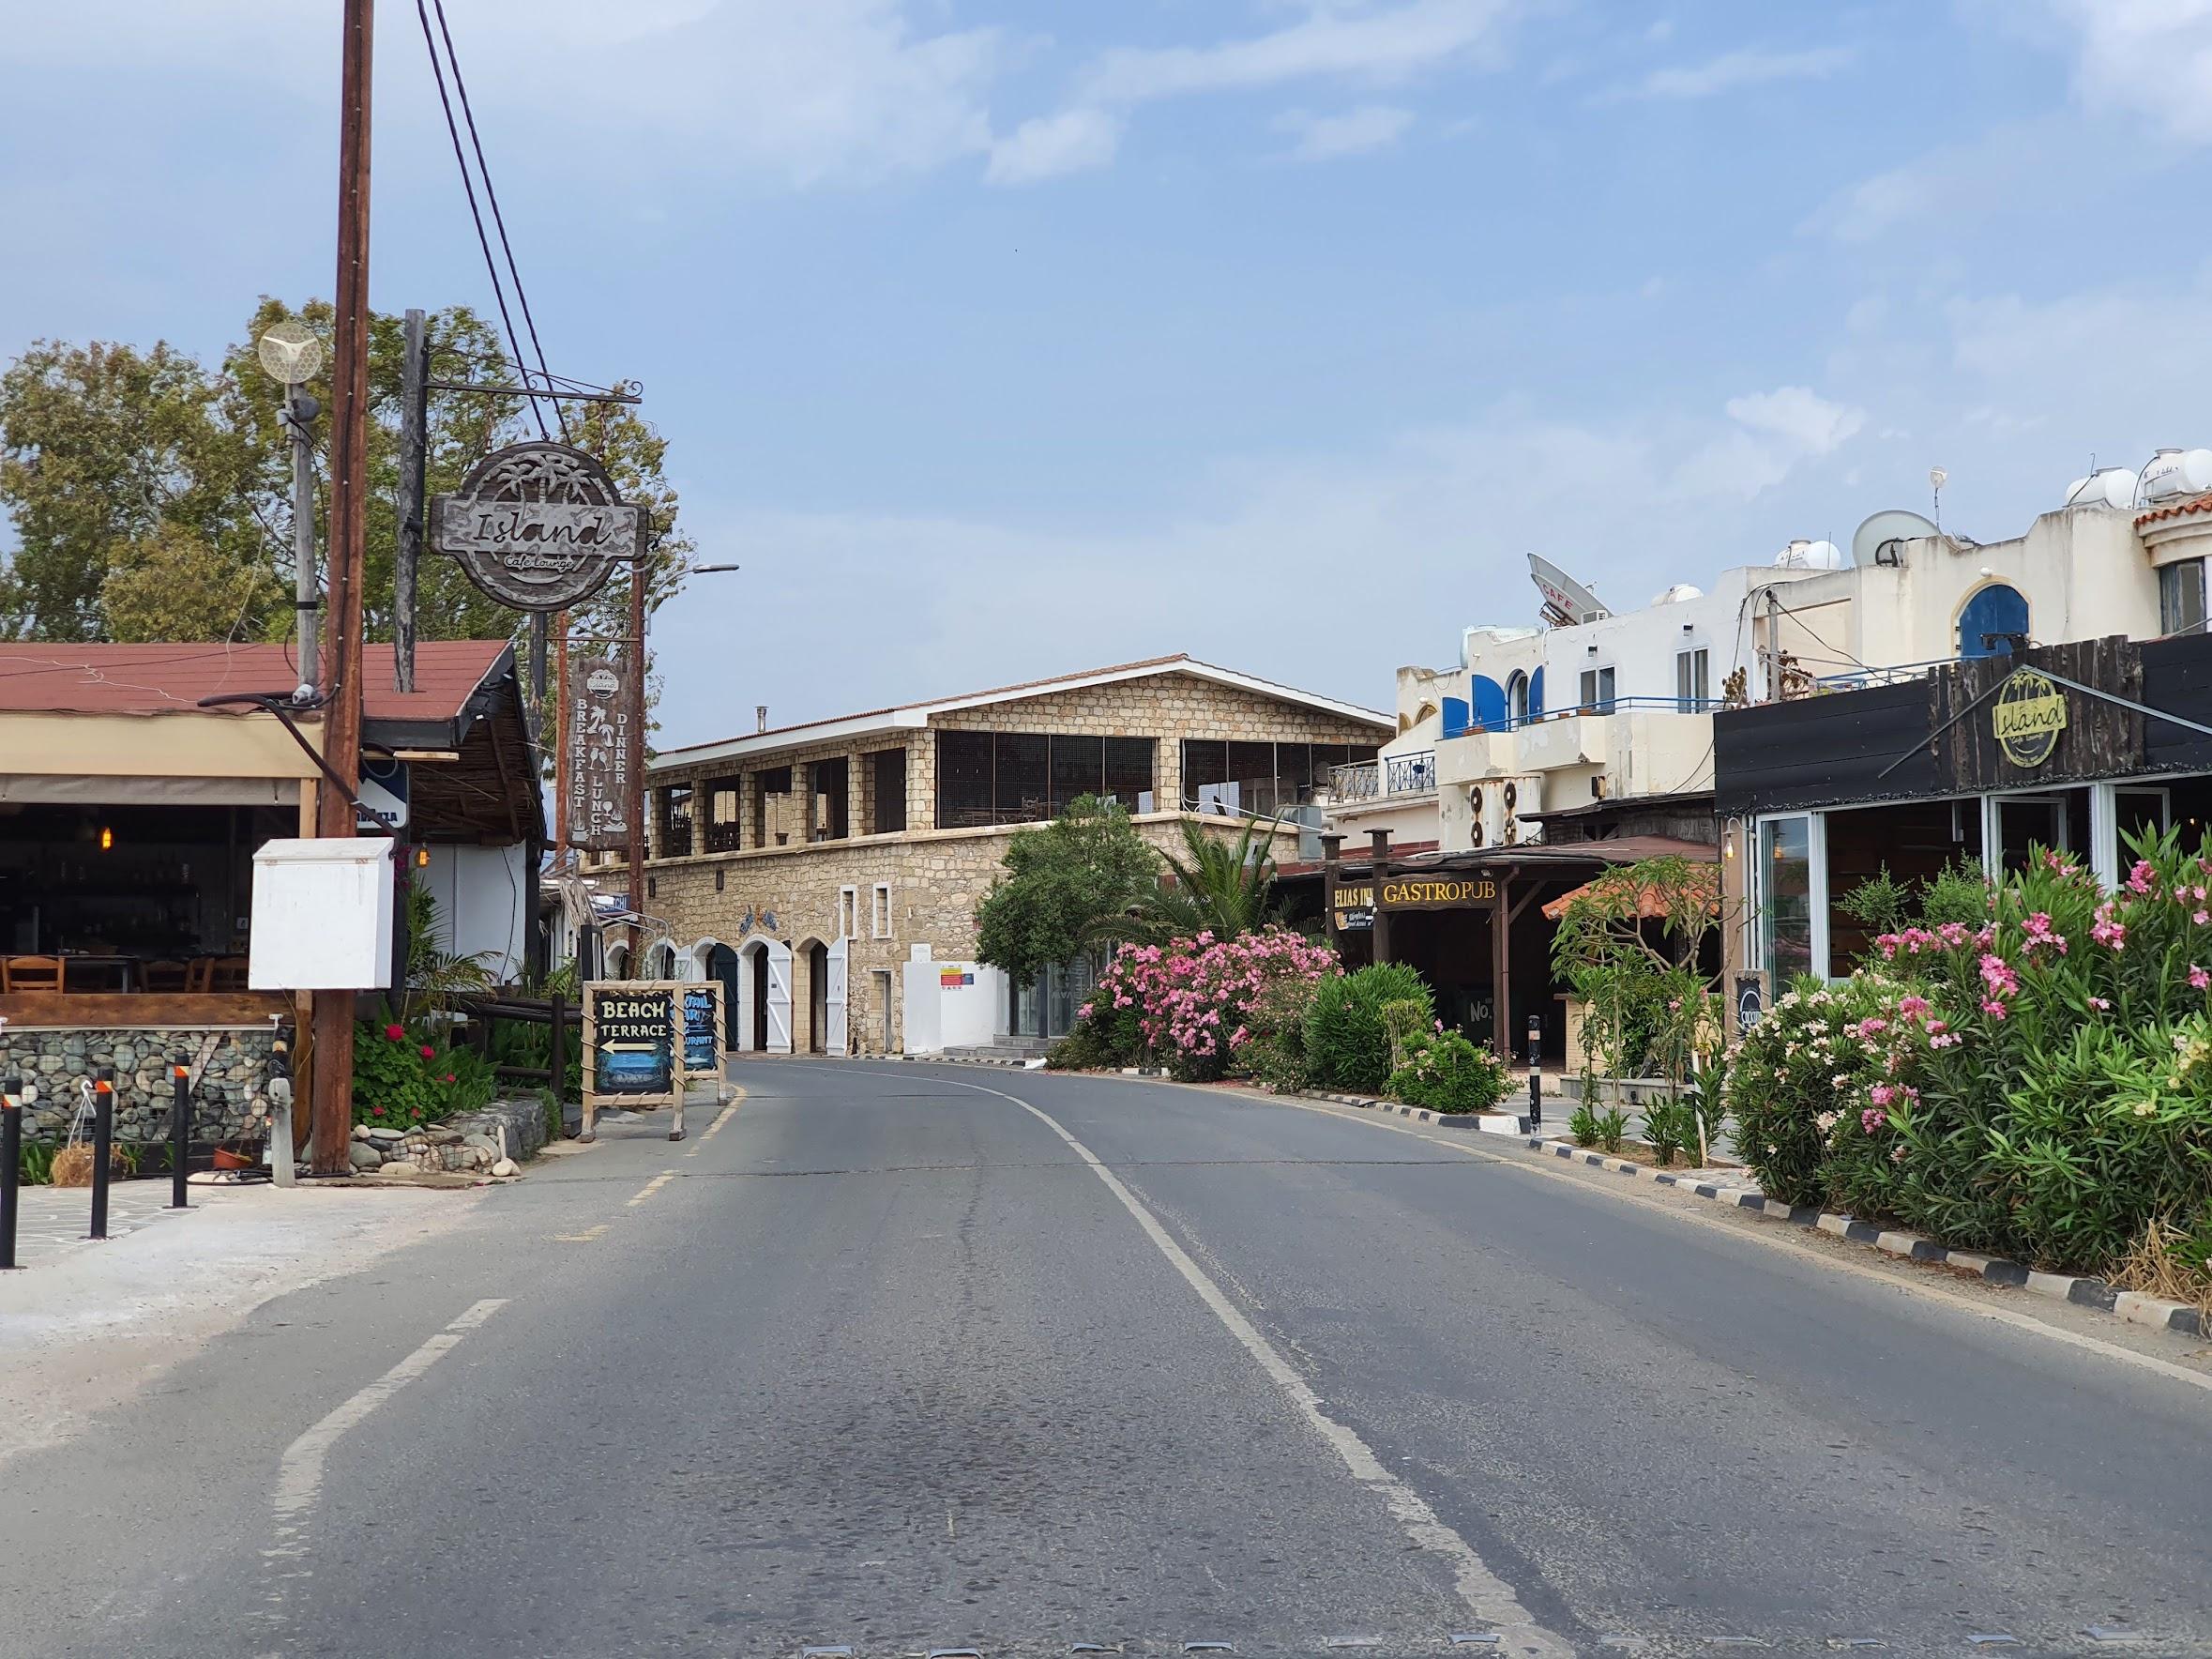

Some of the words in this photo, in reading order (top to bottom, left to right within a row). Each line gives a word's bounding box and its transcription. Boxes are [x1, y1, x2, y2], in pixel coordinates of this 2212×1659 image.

[473, 511, 612, 545] Island
[534, 555, 575, 571] Lounge
[1542, 584, 1573, 610] CAFE
[1995, 698, 2062, 735] Island
[573, 698, 588, 808] BREAKFAST
[615, 713, 629, 784] DINNER
[591, 776, 603, 836] LUNCH
[1334, 888, 1358, 907] ELIAS
[1384, 881, 1496, 903] GASTROPUB
[601, 1000, 665, 1019] BEACH
[600, 1025, 667, 1037] TERRACE
